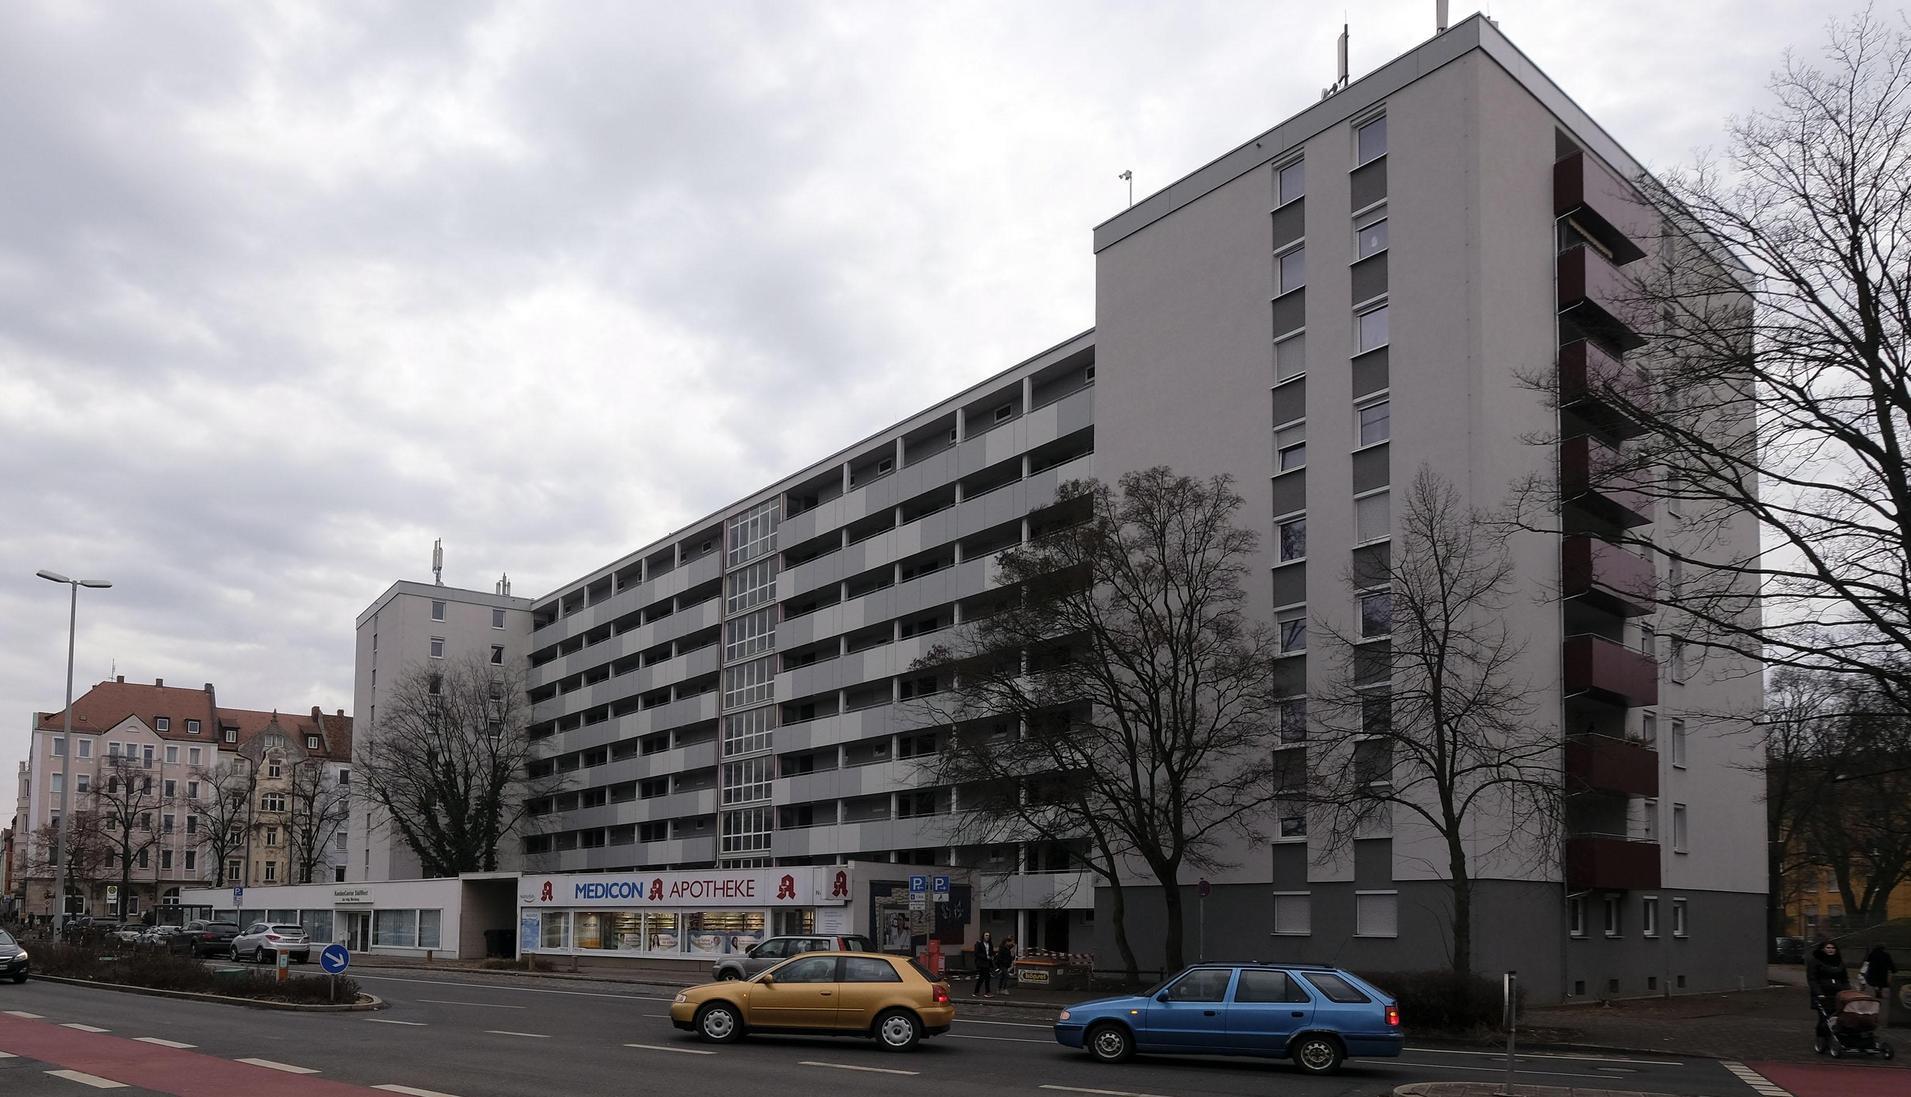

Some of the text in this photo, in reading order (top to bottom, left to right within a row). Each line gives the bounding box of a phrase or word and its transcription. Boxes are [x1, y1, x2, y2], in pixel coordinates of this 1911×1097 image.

[575, 882, 643, 899] MEDICON
[669, 880, 755, 898] APOTHEKE
[913, 877, 923, 891] P
[935, 878, 945, 891] P
